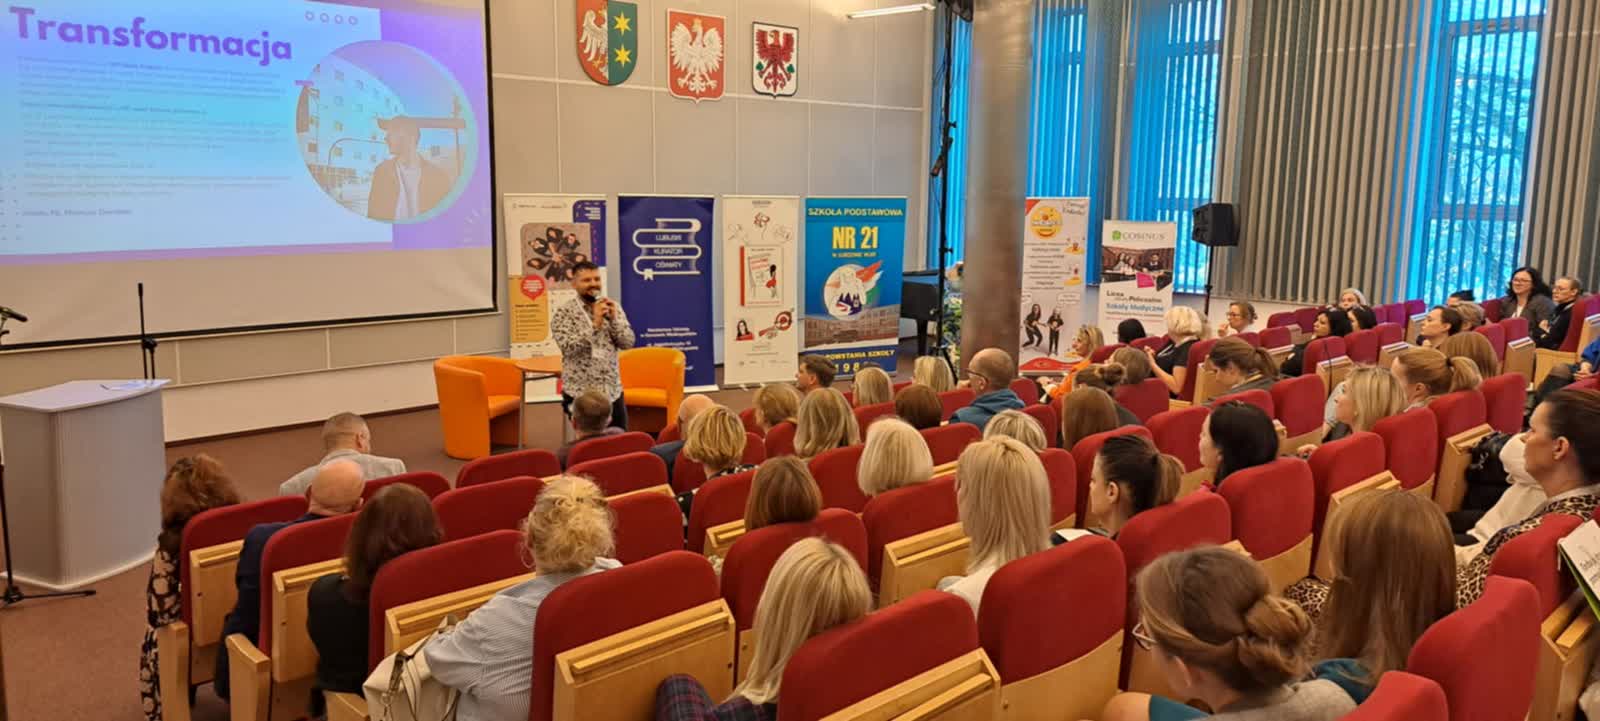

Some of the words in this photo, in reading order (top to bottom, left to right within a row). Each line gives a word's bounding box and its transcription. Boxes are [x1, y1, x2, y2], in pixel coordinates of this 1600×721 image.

[9, 6, 293, 66] Transformacja
[807, 208, 842, 216] SZKOŁA
[844, 208, 903, 216] PODSTAWOWA
[832, 226, 856, 249] NR
[861, 226, 879, 249] 21
